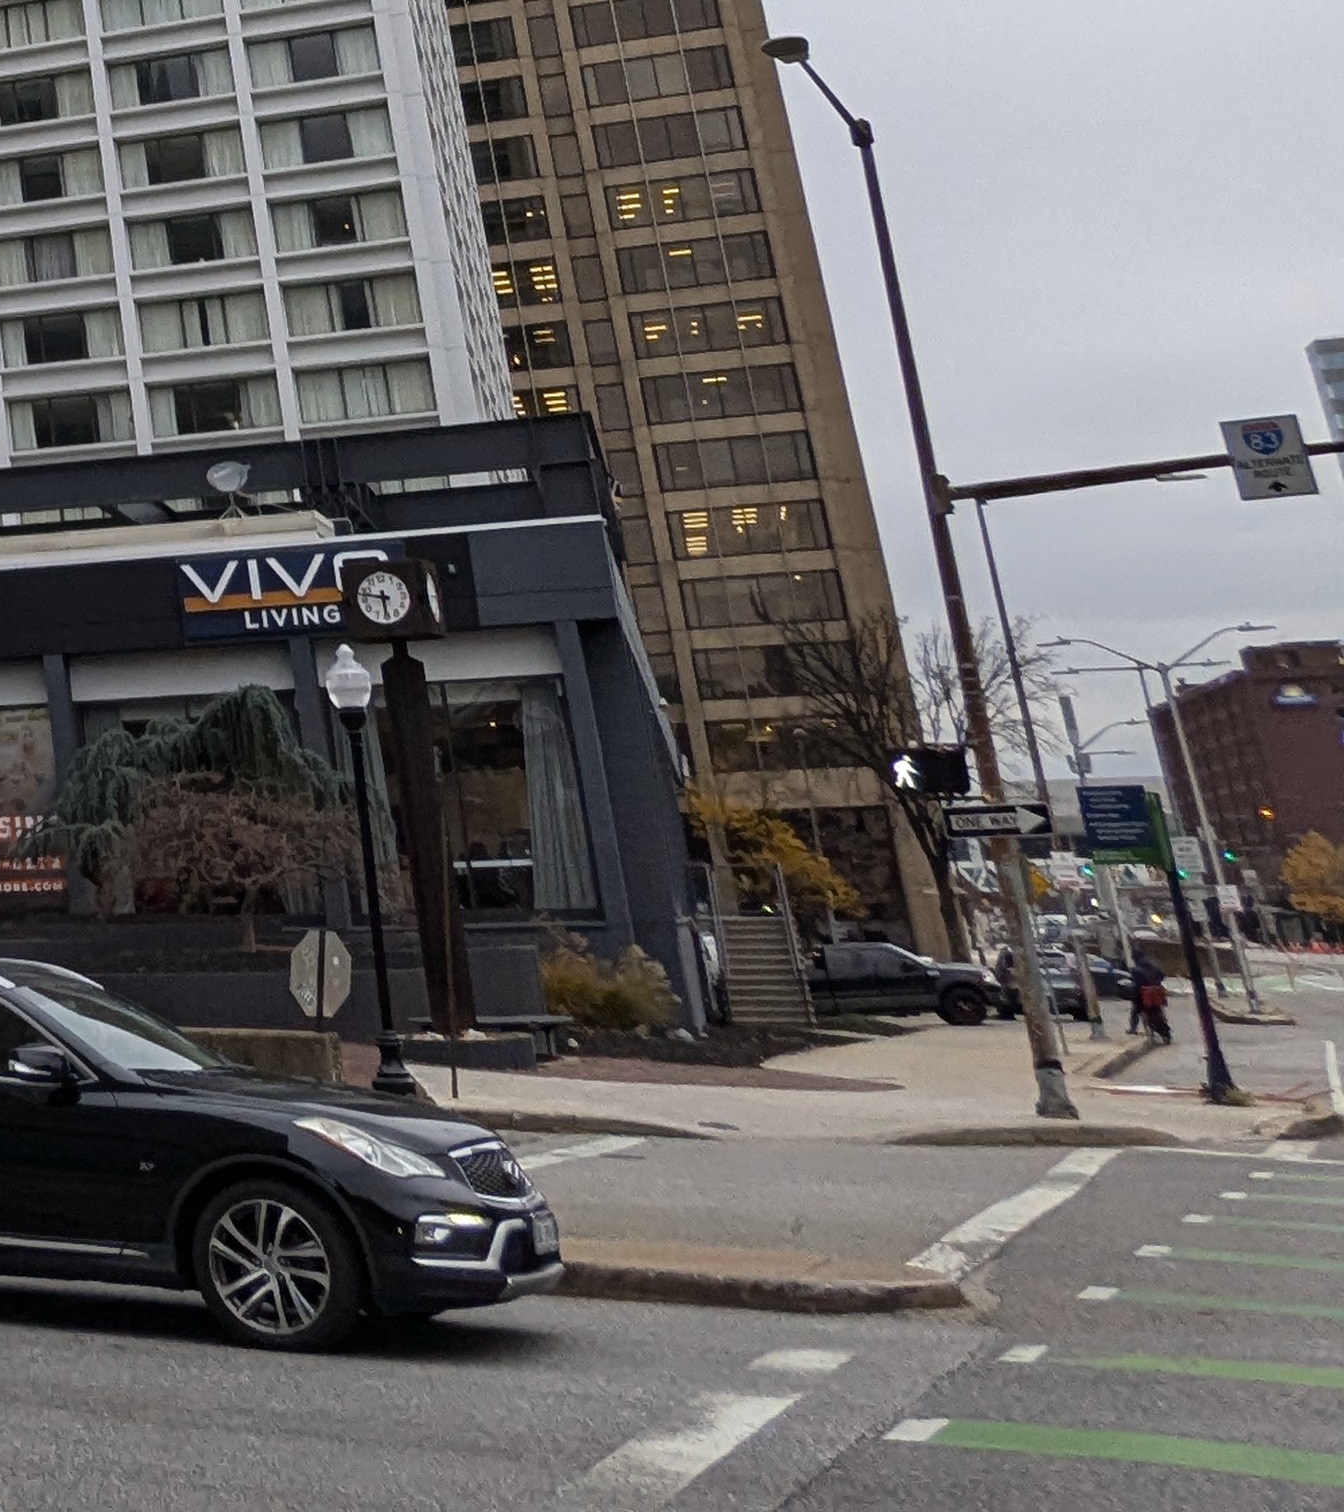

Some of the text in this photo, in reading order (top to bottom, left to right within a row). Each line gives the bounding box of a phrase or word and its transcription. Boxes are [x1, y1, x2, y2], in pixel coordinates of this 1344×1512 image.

[1250, 431, 1280, 450] 83
[244, 605, 342, 630] LIVING
[954, 813, 1016, 829] ONE WAY
